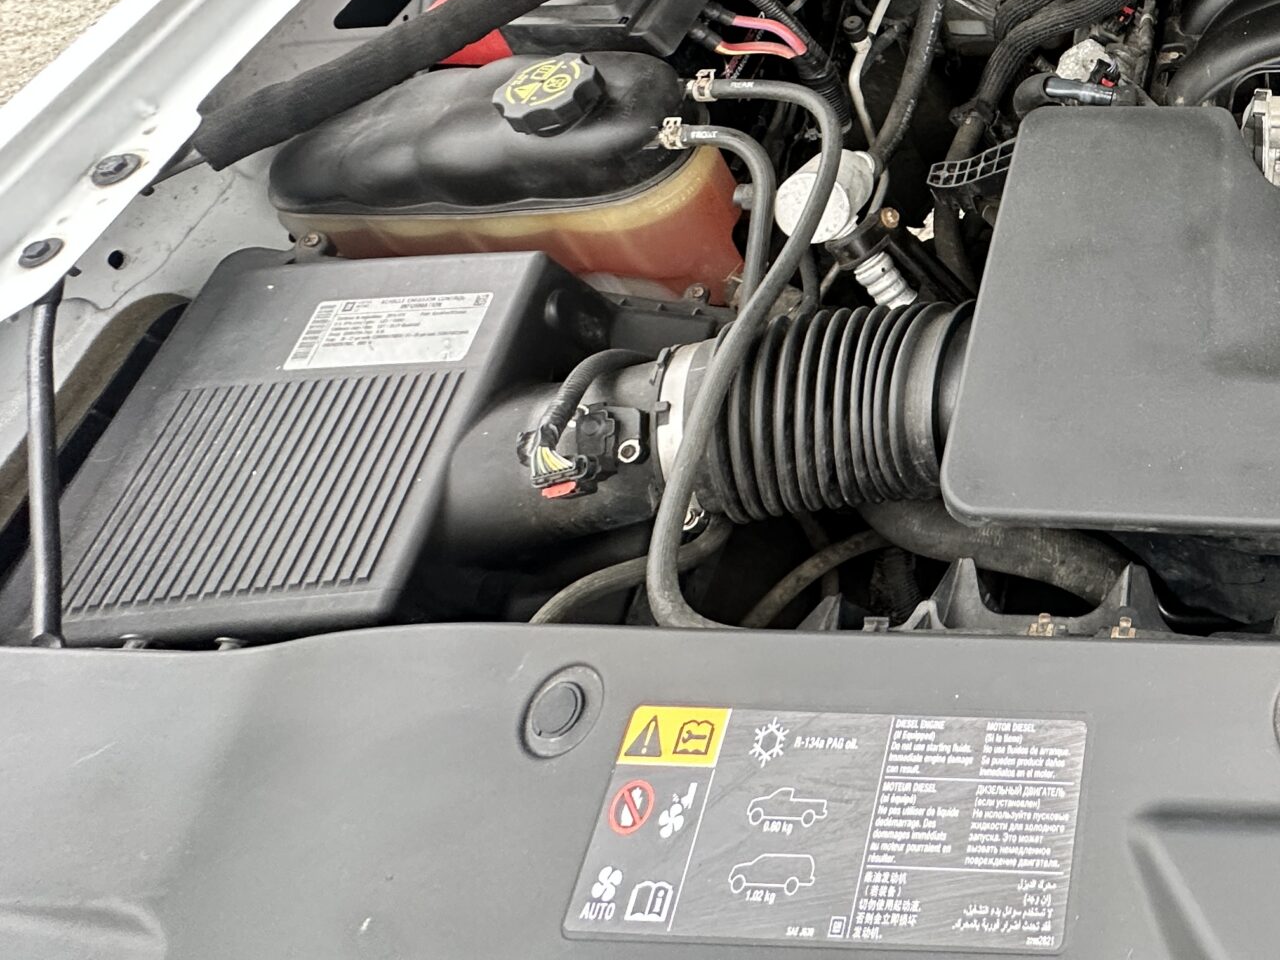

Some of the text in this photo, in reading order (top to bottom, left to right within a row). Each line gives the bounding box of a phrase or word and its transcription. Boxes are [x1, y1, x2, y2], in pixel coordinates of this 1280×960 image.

[690, 130, 719, 139] FRONT
[895, 719, 945, 730] DIESEL ENGINE
[986, 722, 1036, 733] MOTOR DIESEL
[902, 730, 936, 742] Equipped)
[1003, 733, 1023, 745] tiene)
[793, 736, 825, 749] R-134a
[825, 737, 845, 750] PAG
[891, 741, 901, 751] Do
[901, 742, 912, 751] not
[913, 743, 926, 752] use
[926, 742, 951, 754] starting
[983, 744, 993, 754] No
[993, 746, 1006, 754] use
[1029, 746, 1039, 756] de
[888, 752, 974, 767] Immediate engine damage
[981, 755, 1066, 769] Se pueden producir daños
[886, 765, 899, 774] can
[1016, 770, 1026, 778] en
[1026, 768, 1034, 778] el
[882, 781, 937, 793] MOTEUR DIESEL
[975, 784, 1066, 799] ДИЗЕЛЬНЫЙ ДВИГАТЕЛЬ
[974, 797, 1041, 810] (если установлен)
[877, 805, 960, 819] Ne pas utiliser de liquide
[972, 808, 1070, 823] Не используйте пусковые
[781, 820, 794, 836] kg
[922, 818, 937, 829] Des
[970, 822, 1066, 834] жидкости для холодного
[872, 828, 948, 842] dommages immédiats
[1001, 832, 1018, 844] Это
[1017, 835, 1044, 844] может
[869, 841, 952, 855] au moteur pourraient en
[966, 844, 1052, 857] вызвать немедленное
[867, 852, 897, 864] résulter.
[964, 855, 1018, 868] повреждение
[864, 870, 908, 885] 柴油发动机
[745, 889, 777, 906] 1.02 kg
[579, 902, 616, 921] AUTO
[785, 925, 800, 937] SAE
